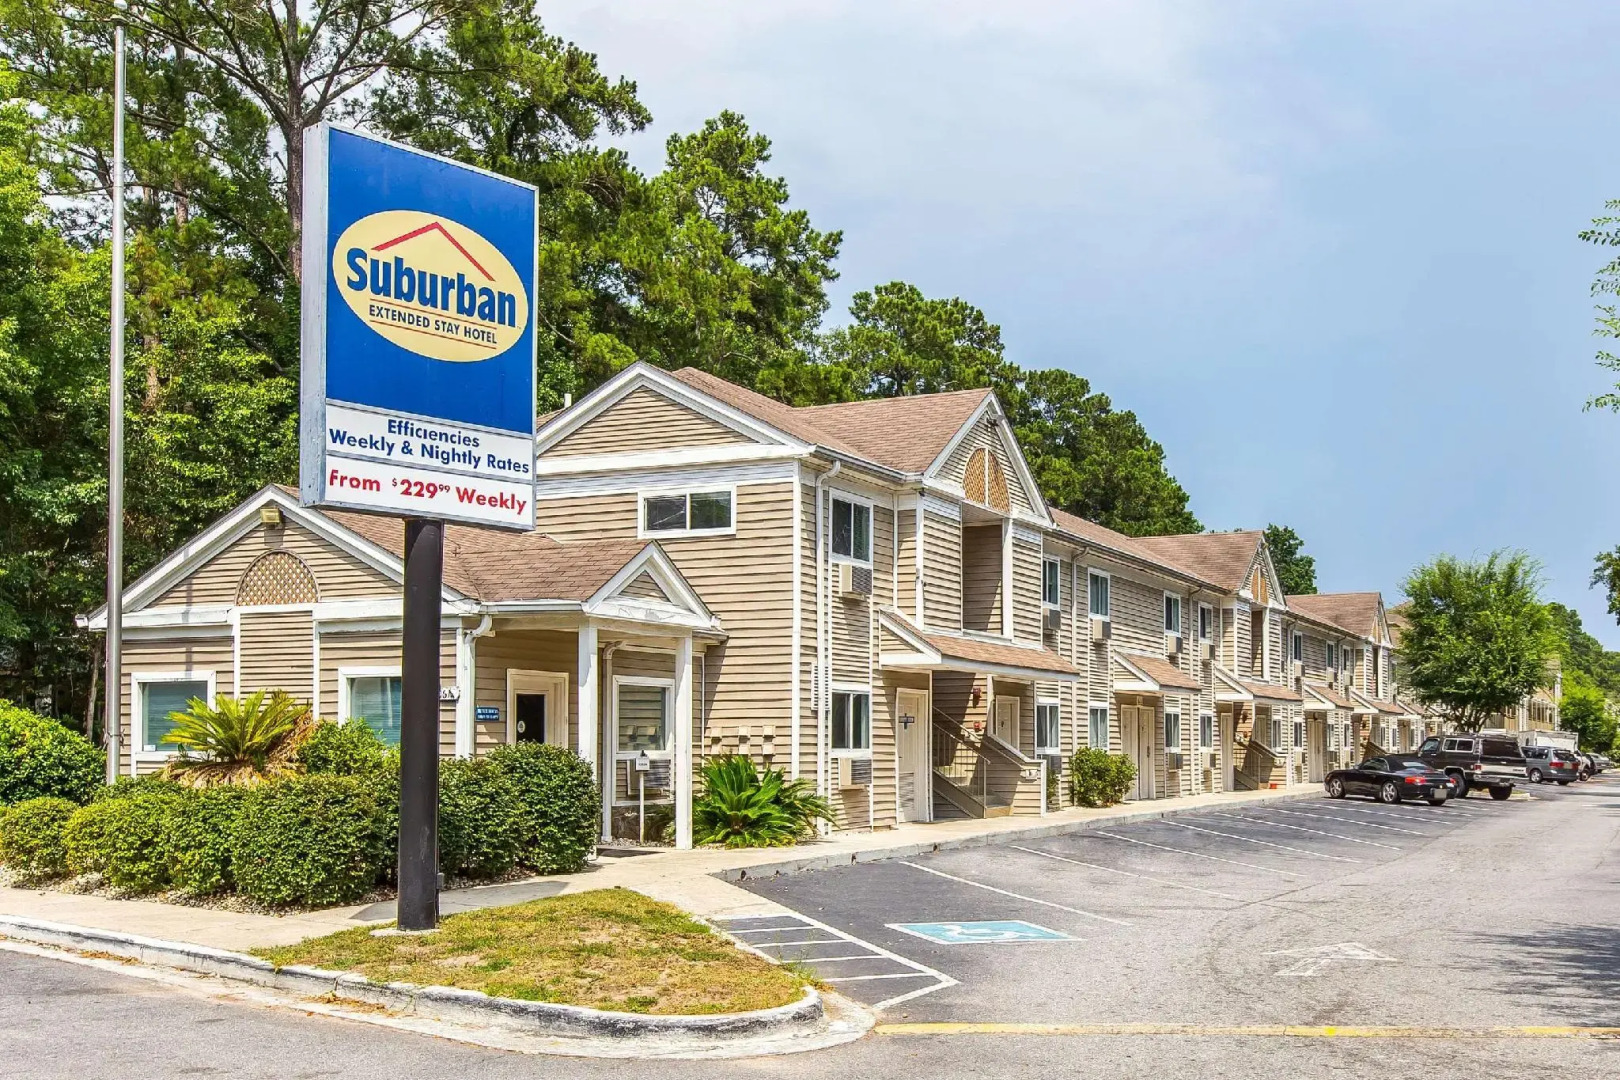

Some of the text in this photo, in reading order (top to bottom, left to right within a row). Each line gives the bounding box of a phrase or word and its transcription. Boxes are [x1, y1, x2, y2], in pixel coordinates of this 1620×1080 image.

[346, 247, 516, 328] Suburban
[369, 304, 498, 344] EXTENDED STAY HOTEL
[329, 428, 529, 474] Weekly & Nightly Rates
[387, 419, 480, 448] Efficiencies
[329, 469, 381, 492] From
[455, 486, 528, 515] Weekly
